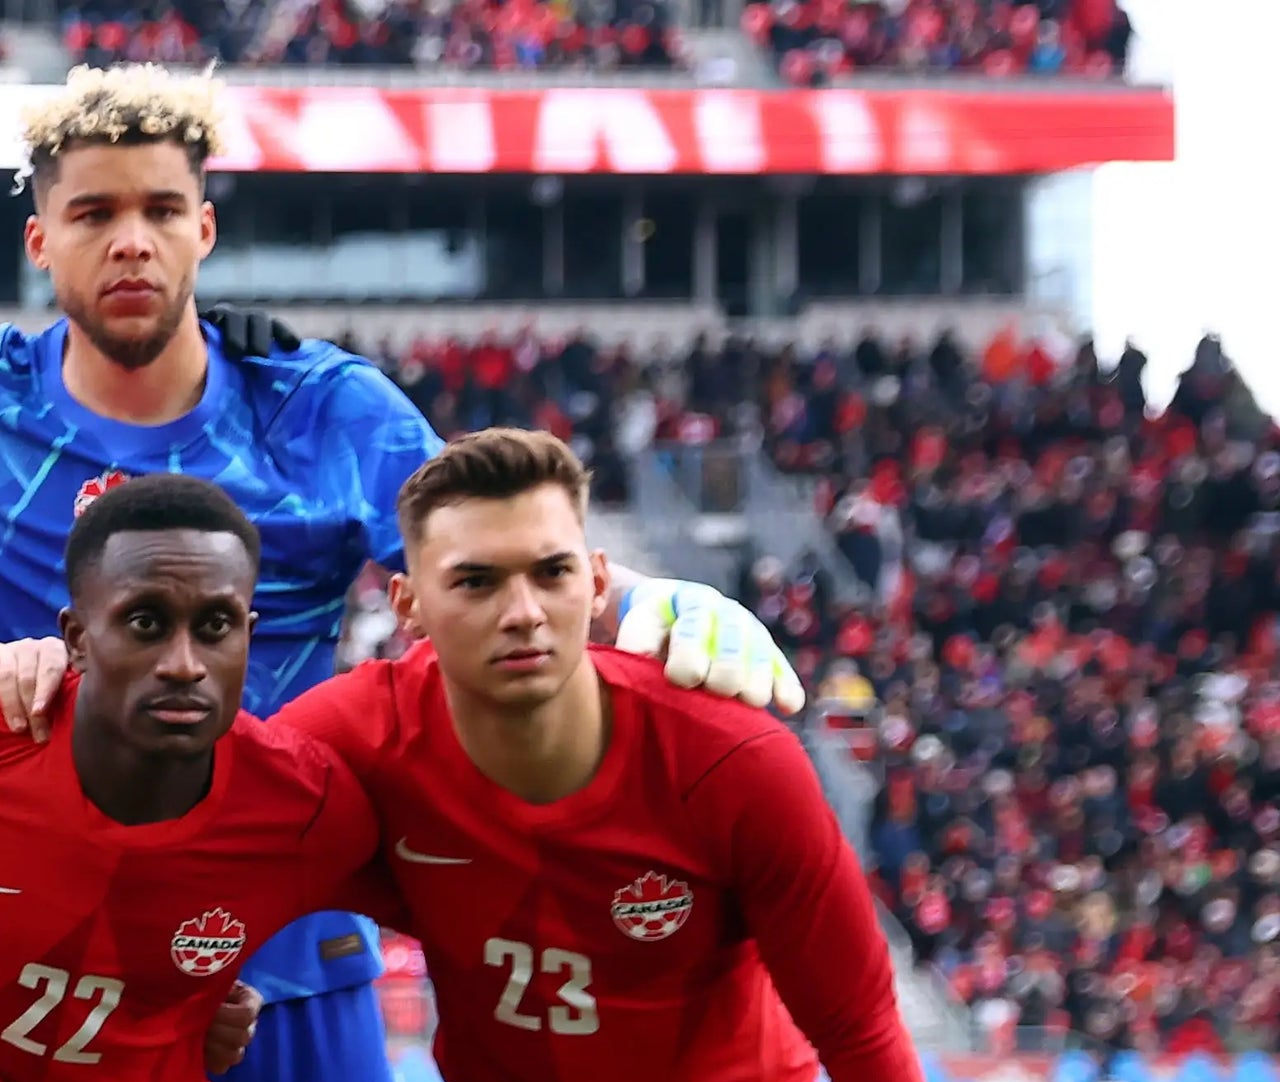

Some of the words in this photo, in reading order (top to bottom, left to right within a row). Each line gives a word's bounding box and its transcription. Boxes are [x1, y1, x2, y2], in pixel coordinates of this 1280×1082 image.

[173, 937, 241, 949] CANADA
[484, 937, 600, 1035] 23
[0, 962, 125, 1064] 22
